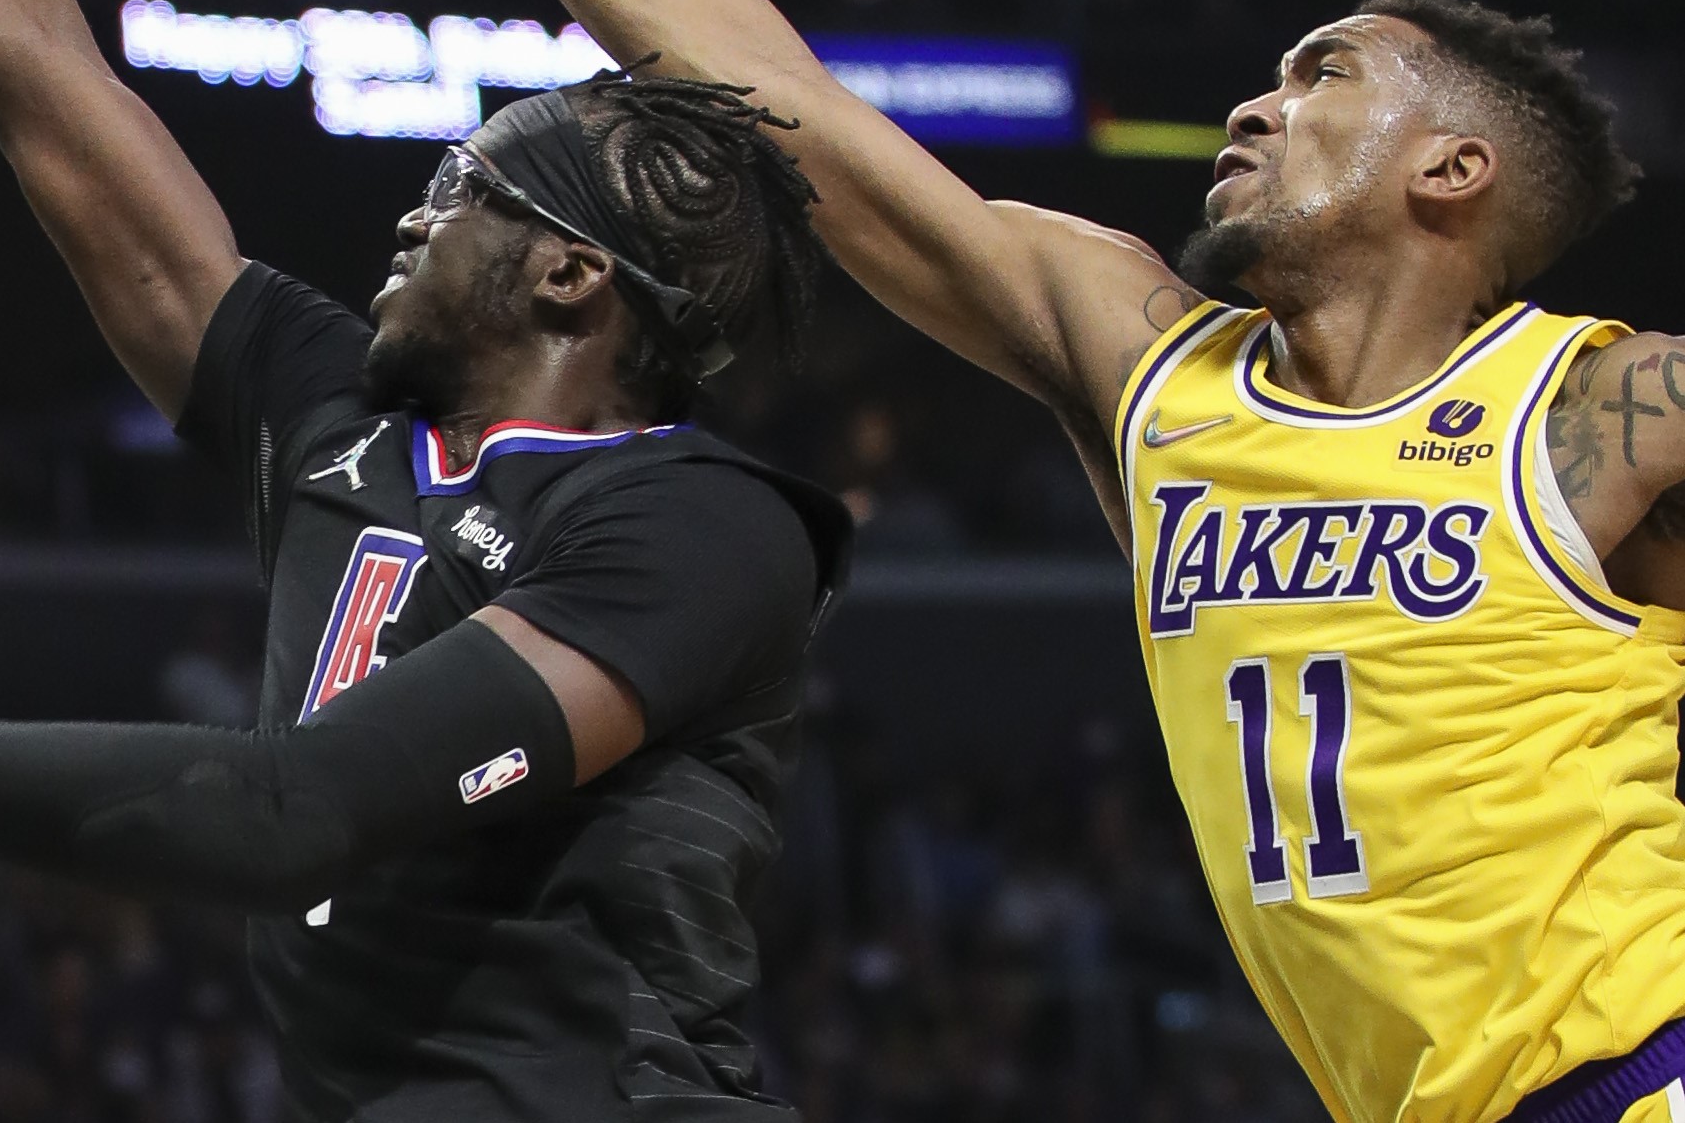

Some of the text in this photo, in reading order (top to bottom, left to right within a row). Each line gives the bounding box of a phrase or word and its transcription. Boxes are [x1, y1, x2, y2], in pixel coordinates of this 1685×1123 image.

[1397, 438, 1494, 467] bibigo
[450, 505, 515, 572] honey
[1149, 480, 1494, 640] LAKERS
[1223, 651, 1370, 907] 11
